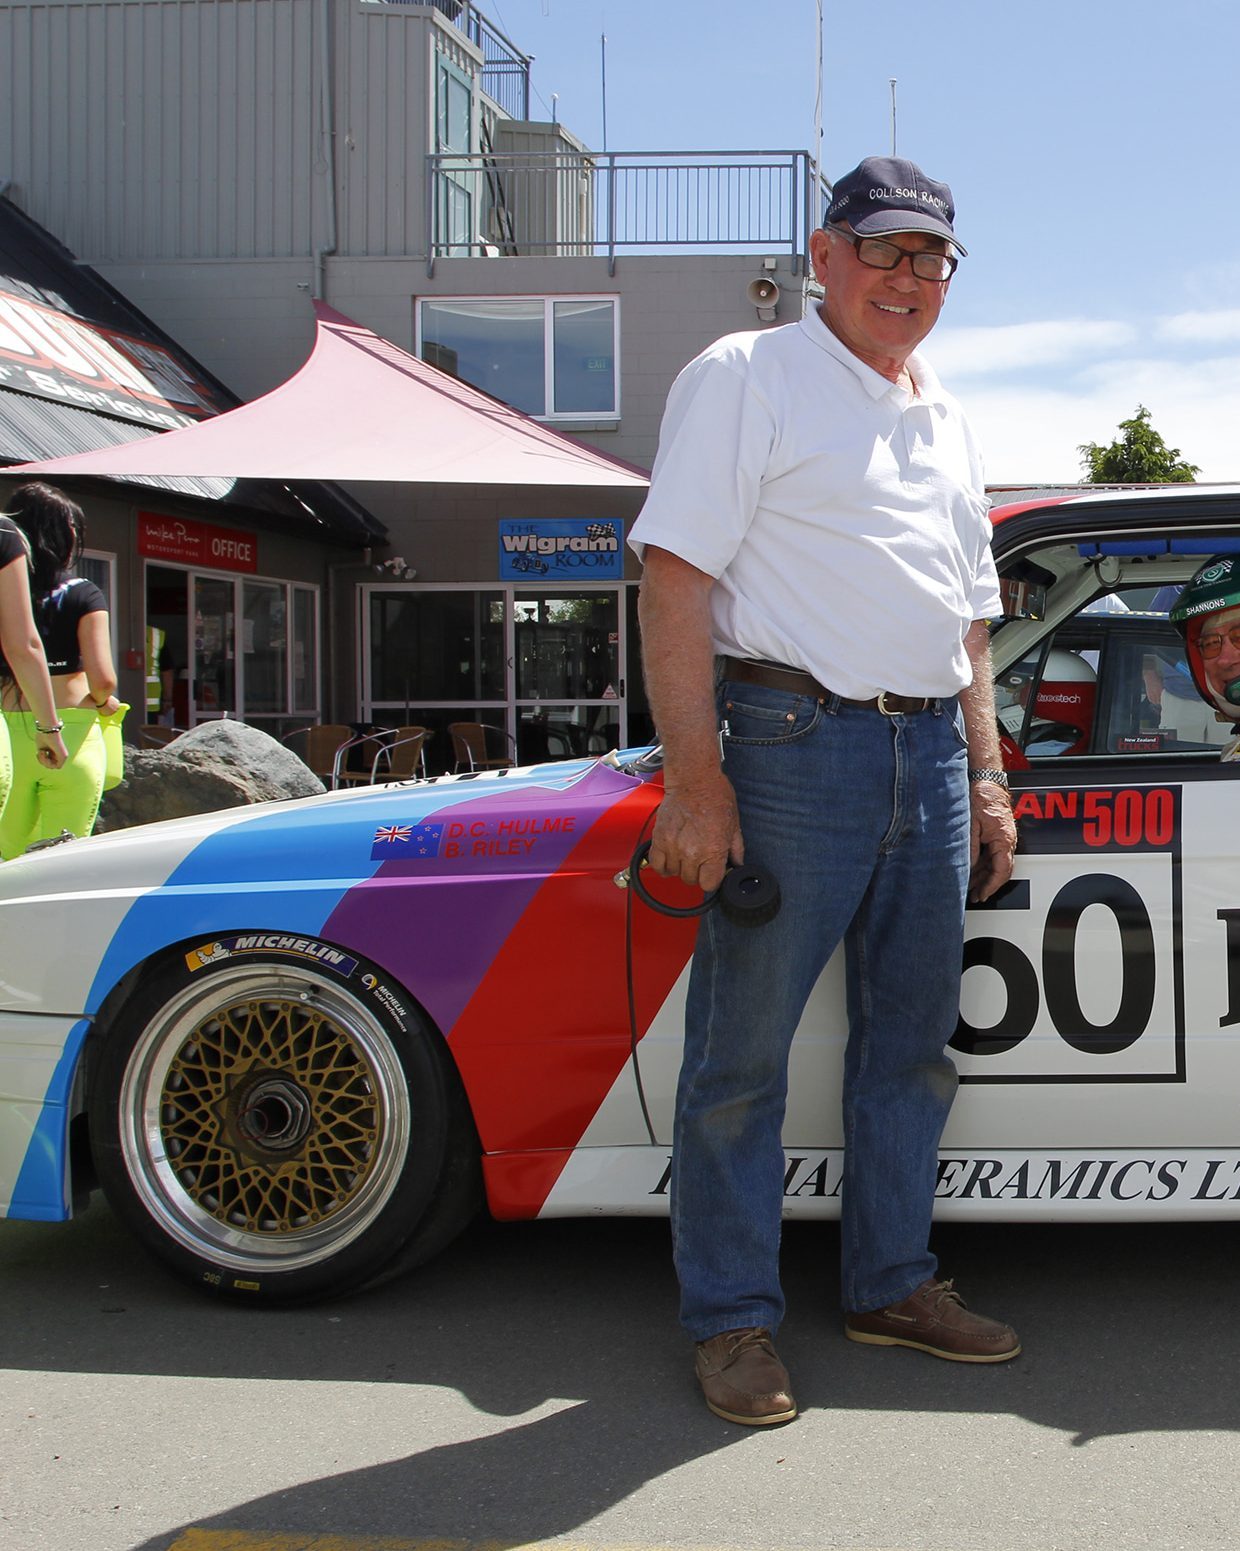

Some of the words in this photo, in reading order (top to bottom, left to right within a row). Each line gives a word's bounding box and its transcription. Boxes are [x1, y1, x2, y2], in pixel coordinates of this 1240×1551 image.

[869, 187, 918, 200] COLLSON
[588, 359, 606, 369] EXIT
[211, 538, 252, 561] OFFICE
[502, 535, 618, 555] Wigram
[556, 554, 614, 567] ROOM
[1186, 598, 1226, 616] SHANNONS
[448, 821, 490, 839] D.C.
[497, 816, 577, 836] HULME
[1083, 789, 1175, 847] 500
[444, 842, 465, 859] B.
[471, 837, 537, 857] RILEY
[234, 936, 346, 965] MICHELIN
[378, 985, 407, 1016] MICHELIN
[935, 1159, 1187, 1200] ERAMICS
